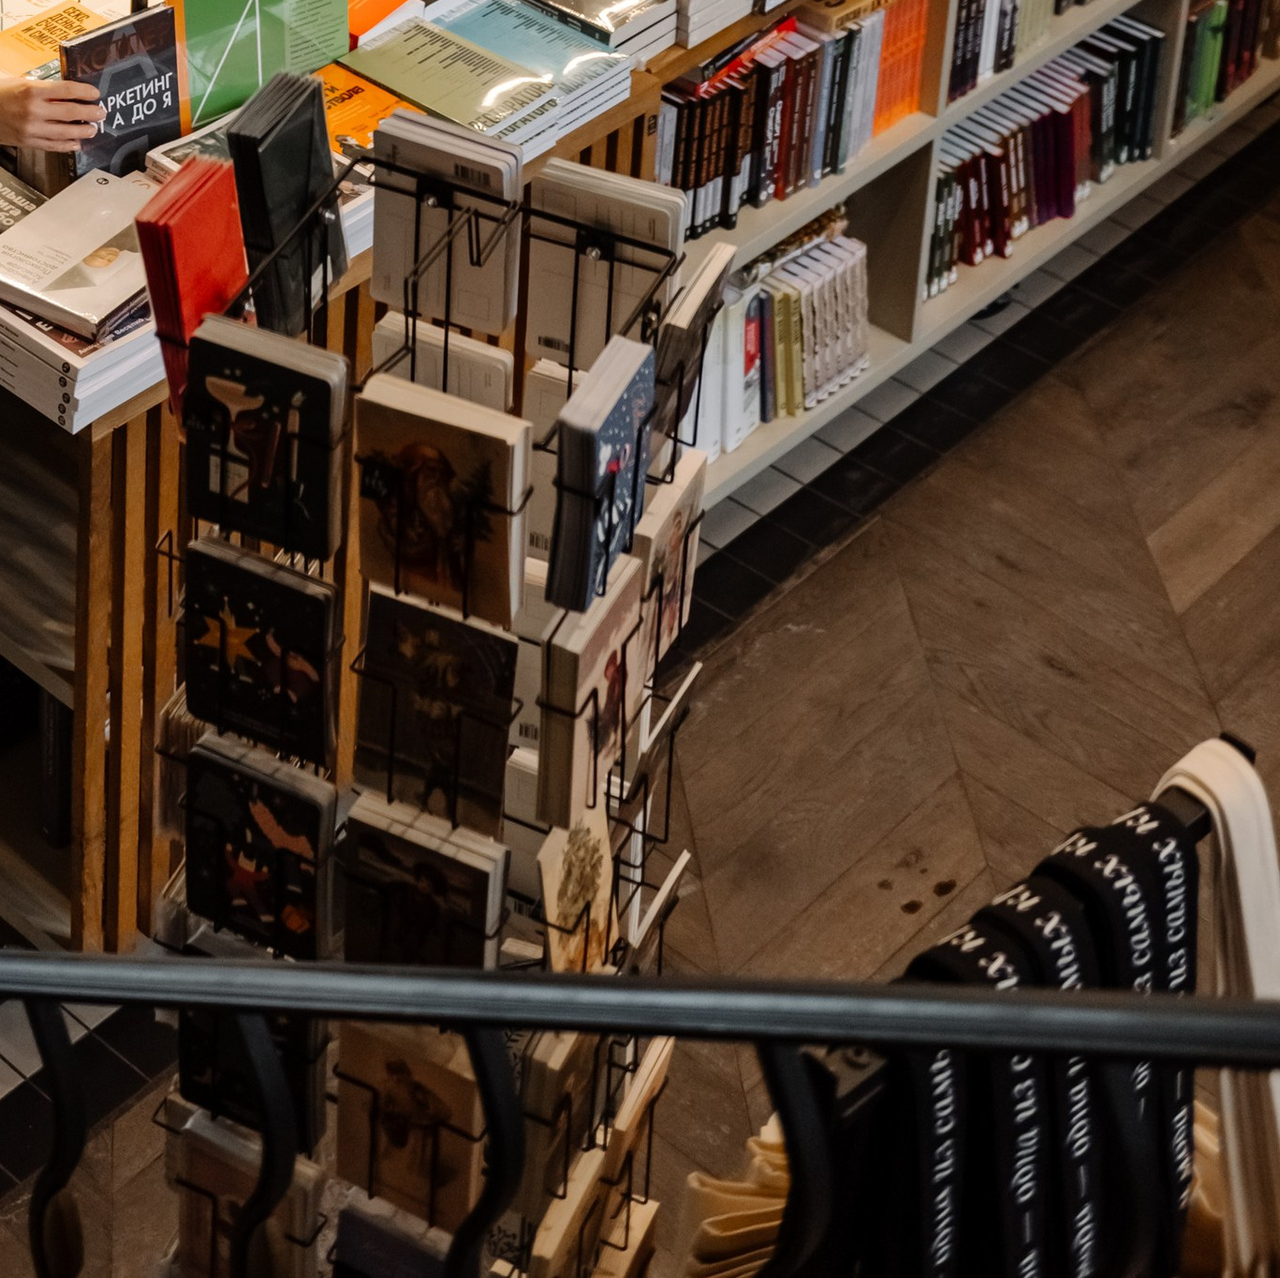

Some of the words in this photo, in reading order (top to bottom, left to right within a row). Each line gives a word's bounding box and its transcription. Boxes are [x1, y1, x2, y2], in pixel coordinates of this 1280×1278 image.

[35, 18, 70, 43] СЧАСТЬ
[99, 72, 174, 114] АРКЕТИНГ
[112, 112, 125, 129] А
[131, 98, 157, 125] ДО
[162, 91, 172, 109] Я
[1094, 854, 1151, 968] самых
[1150, 836, 1187, 944] самых
[1167, 946, 1188, 991] из
[1011, 1077, 1038, 1125] из
[1064, 1077, 1092, 1159] одна
[931, 1138, 954, 1185] из
[1010, 1124, 1041, 1206] одна
[930, 1185, 954, 1268] одна
